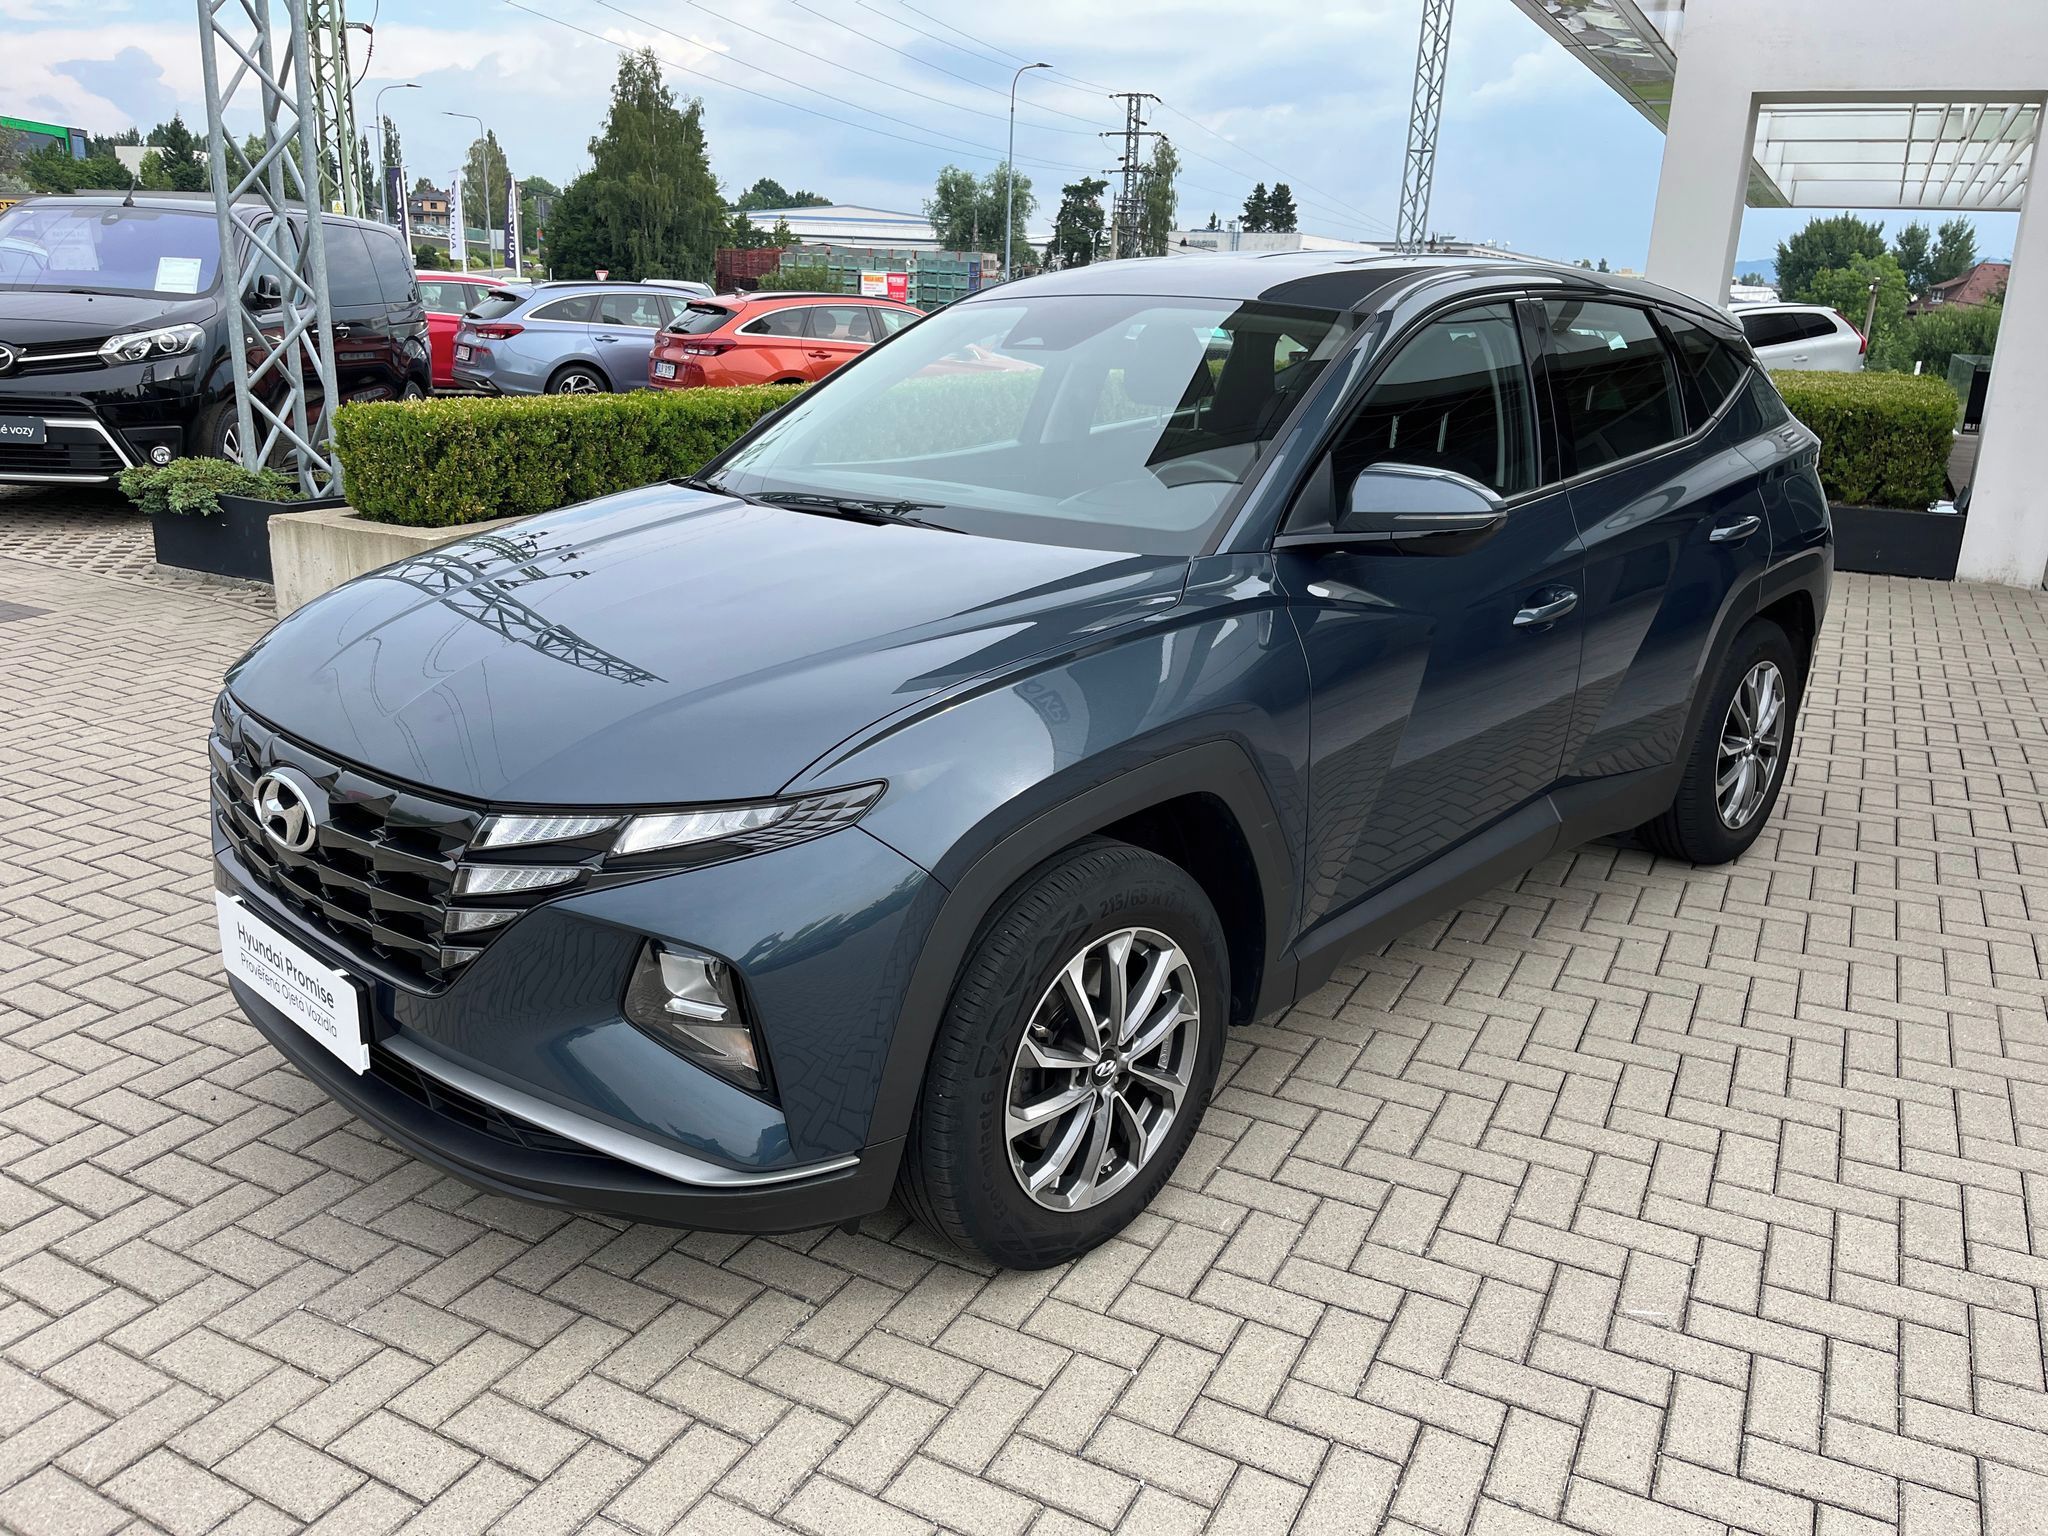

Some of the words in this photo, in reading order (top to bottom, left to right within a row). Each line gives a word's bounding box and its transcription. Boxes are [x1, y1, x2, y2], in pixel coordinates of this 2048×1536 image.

[0, 424, 8, 434] é
[9, 426, 34, 438] vozy
[237, 921, 284, 971] Hyundai
[285, 956, 335, 1009] Promise
[240, 951, 281, 994] Prověřená
[281, 984, 305, 1012] Ojetá
[305, 1001, 337, 1037] Vozidla
